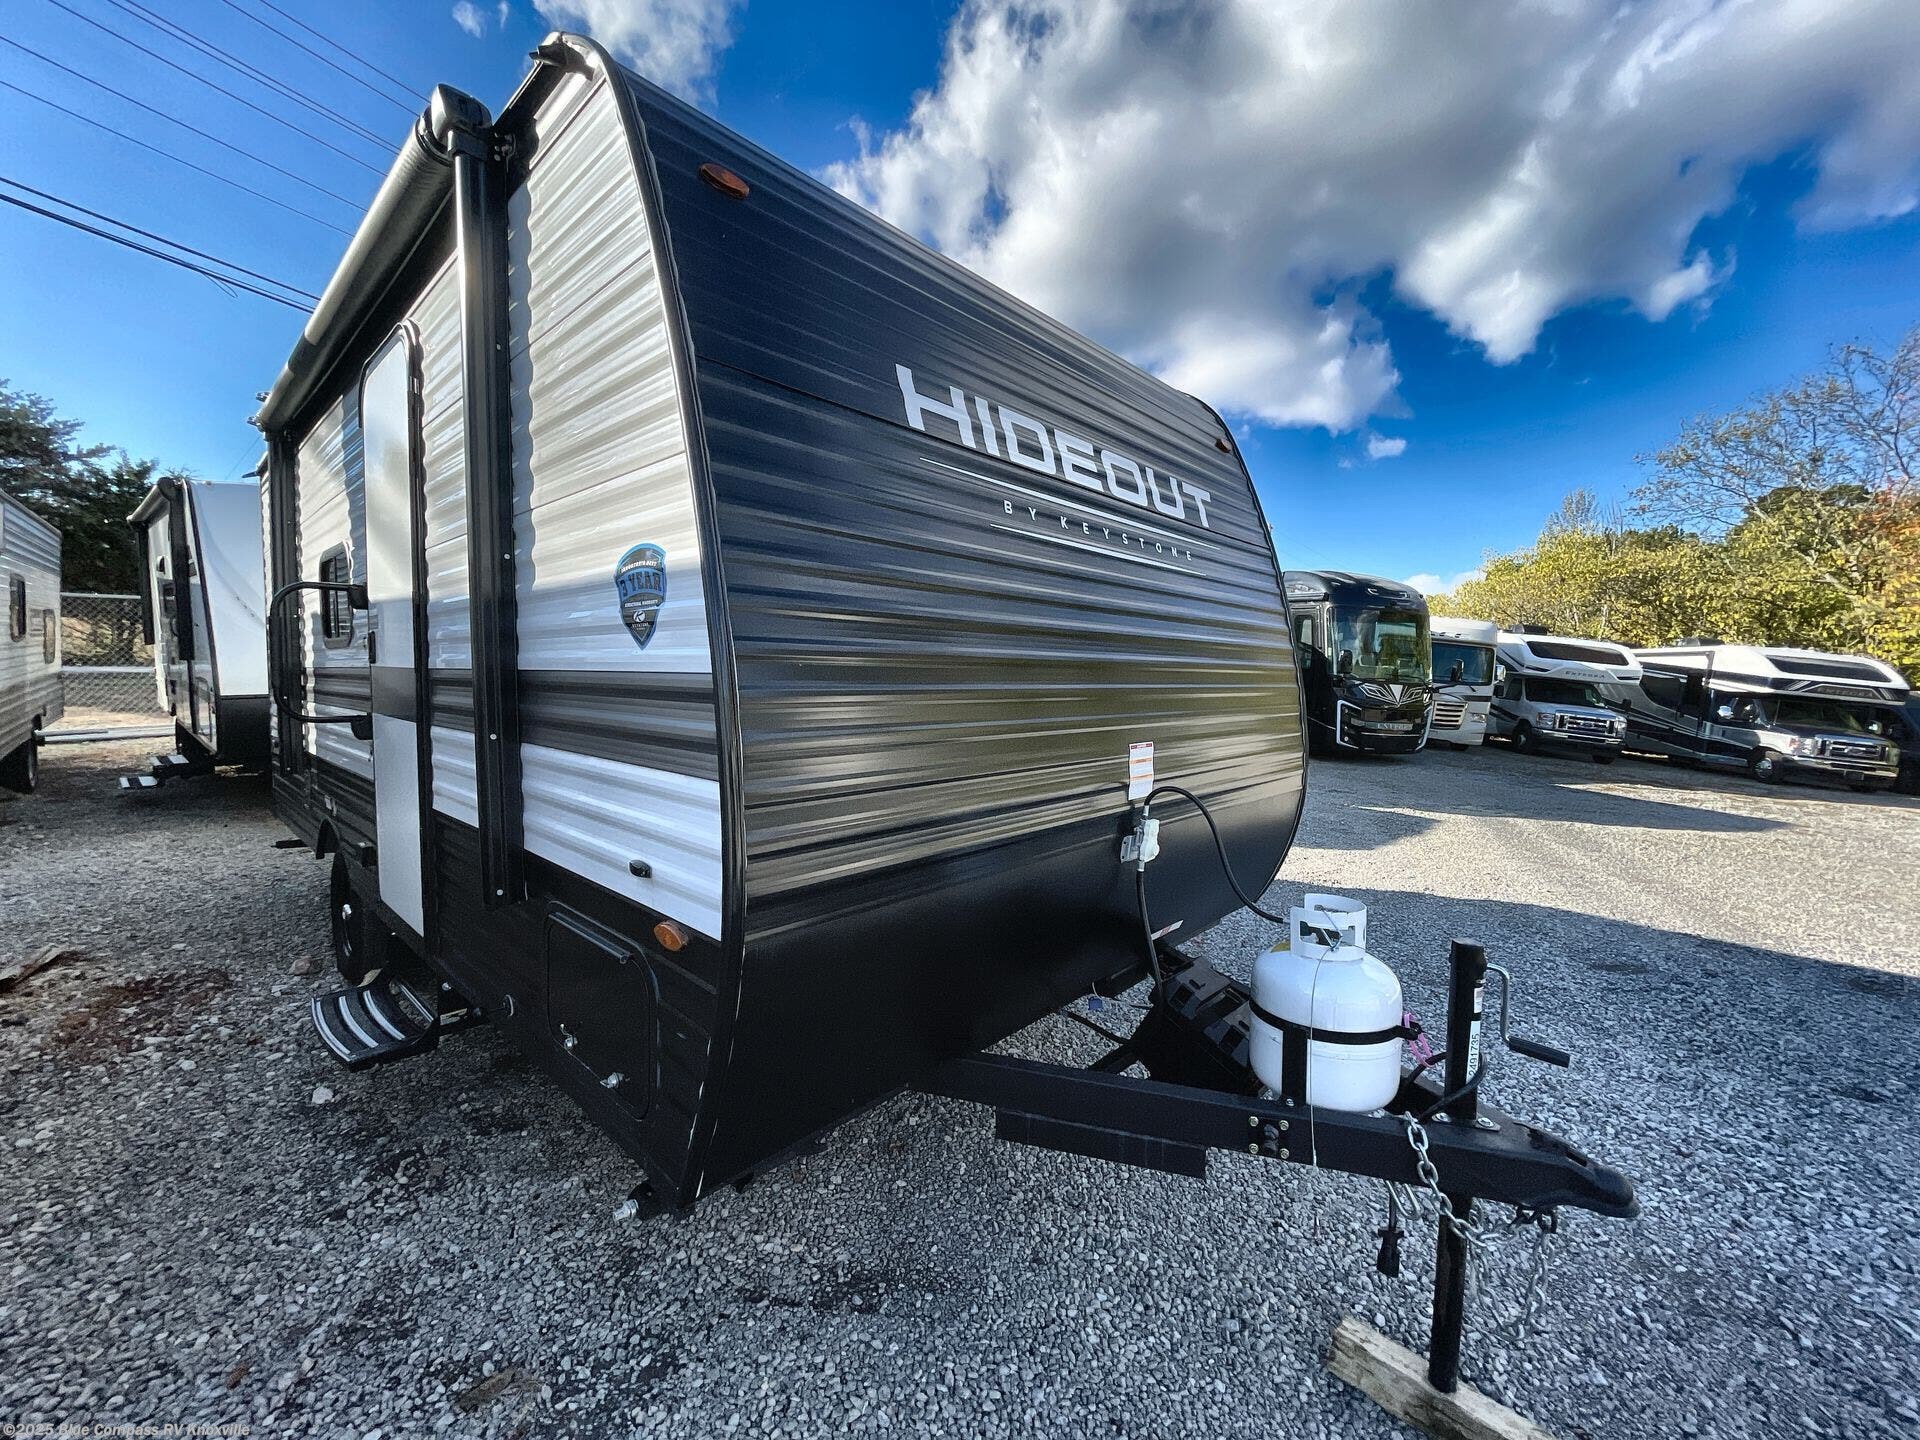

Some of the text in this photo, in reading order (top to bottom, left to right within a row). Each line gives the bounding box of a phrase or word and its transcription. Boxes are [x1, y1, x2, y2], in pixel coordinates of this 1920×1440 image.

[896, 363, 1211, 528] HIDEOUT
[1003, 499, 1192, 561] BY KEYSTONE
